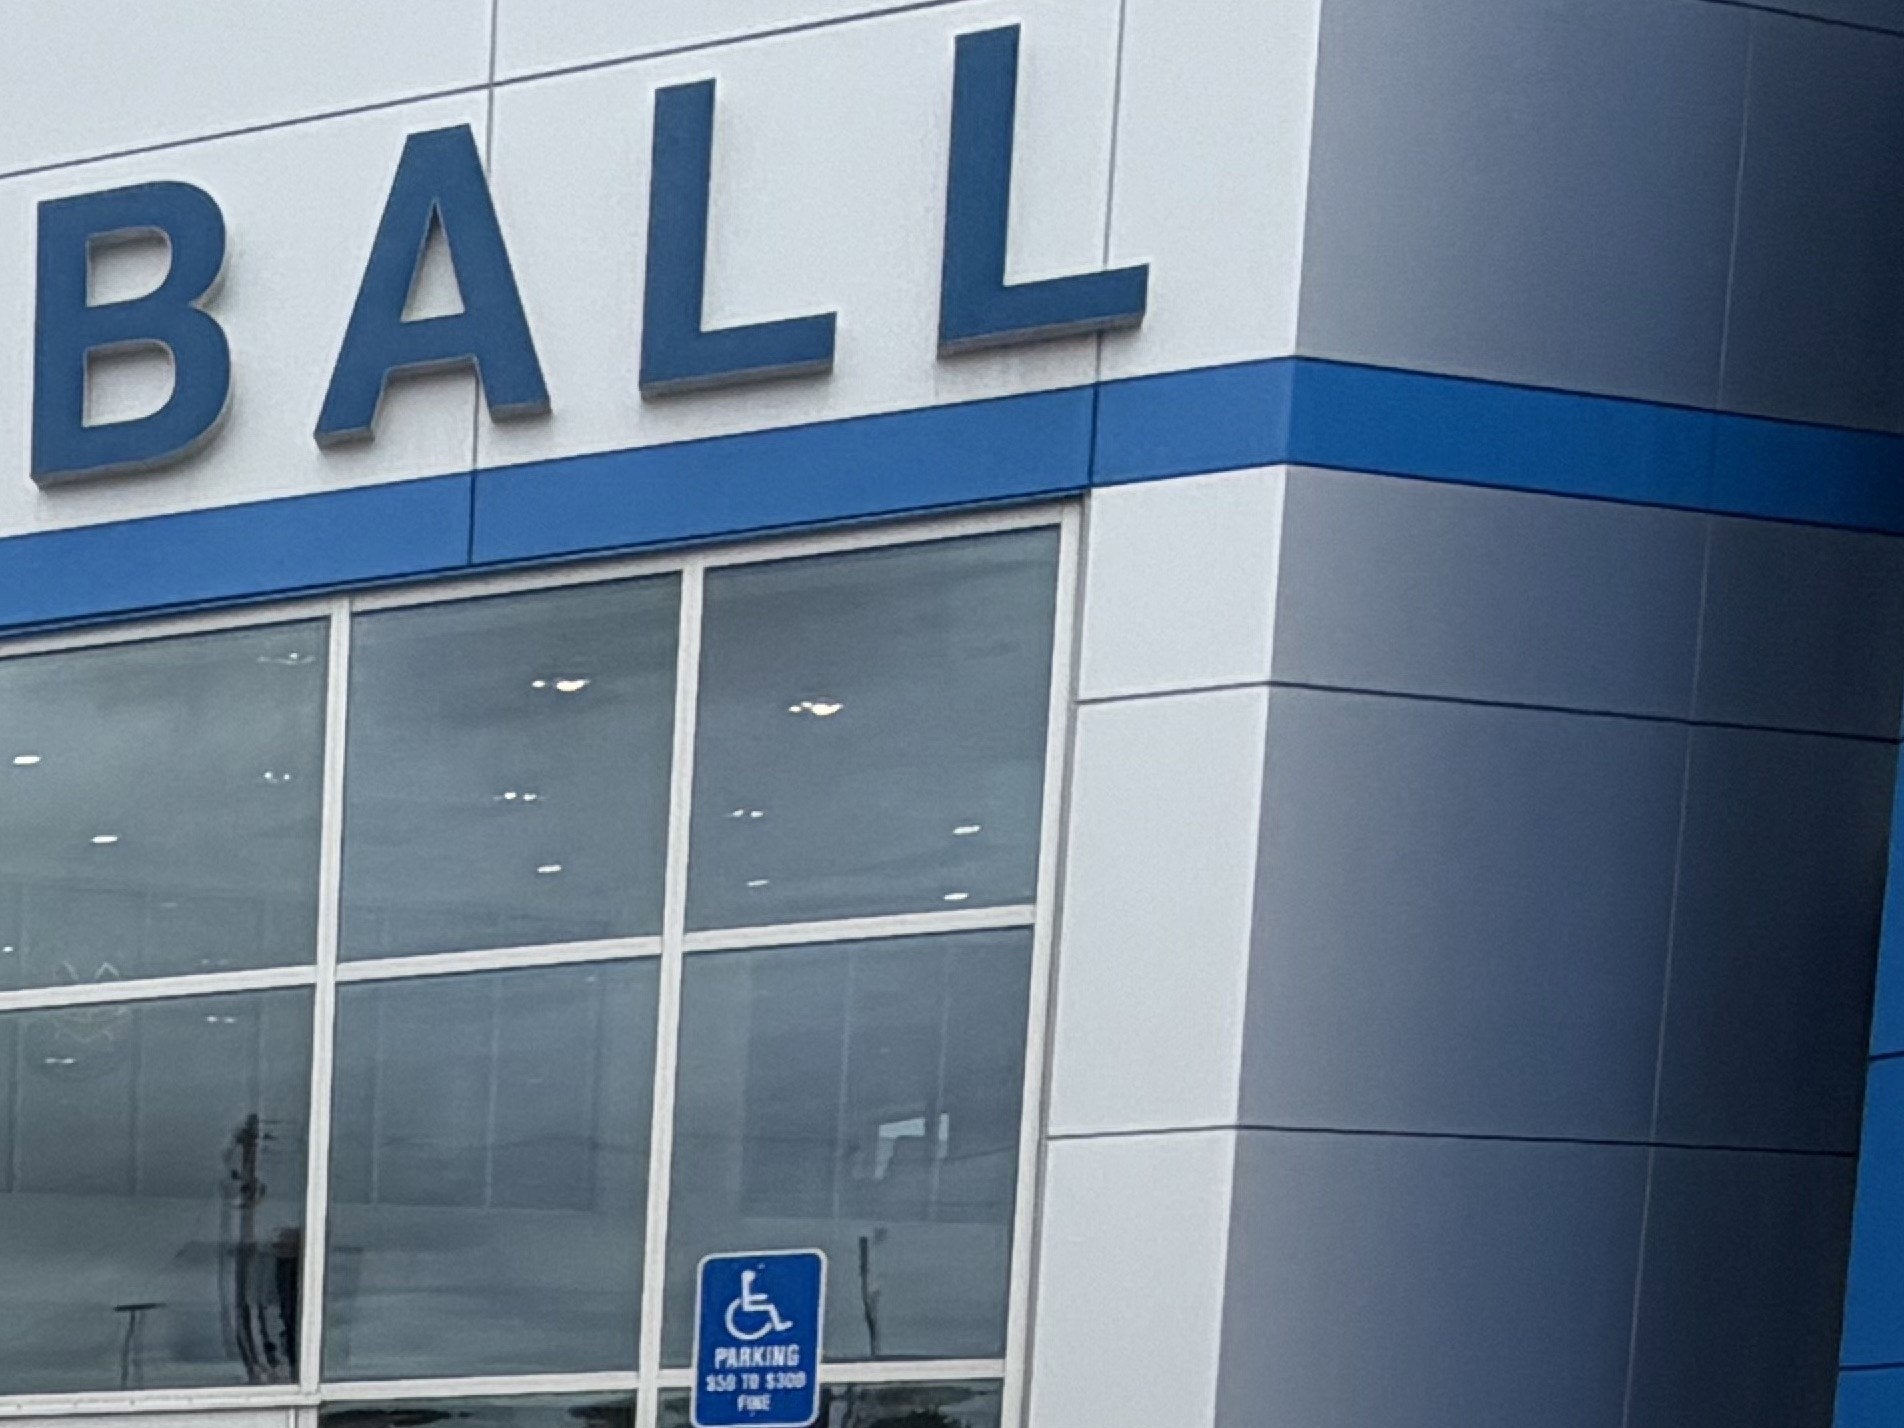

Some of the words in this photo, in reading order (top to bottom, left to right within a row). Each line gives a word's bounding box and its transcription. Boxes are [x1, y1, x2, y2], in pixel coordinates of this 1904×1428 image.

[29, 22, 1150, 488] BALL
[714, 1344, 800, 1369] PARKING
[706, 1373, 736, 1391] $50
[741, 1373, 760, 1389] TO
[765, 1371, 807, 1390] $300
[736, 1394, 772, 1412] FINE
